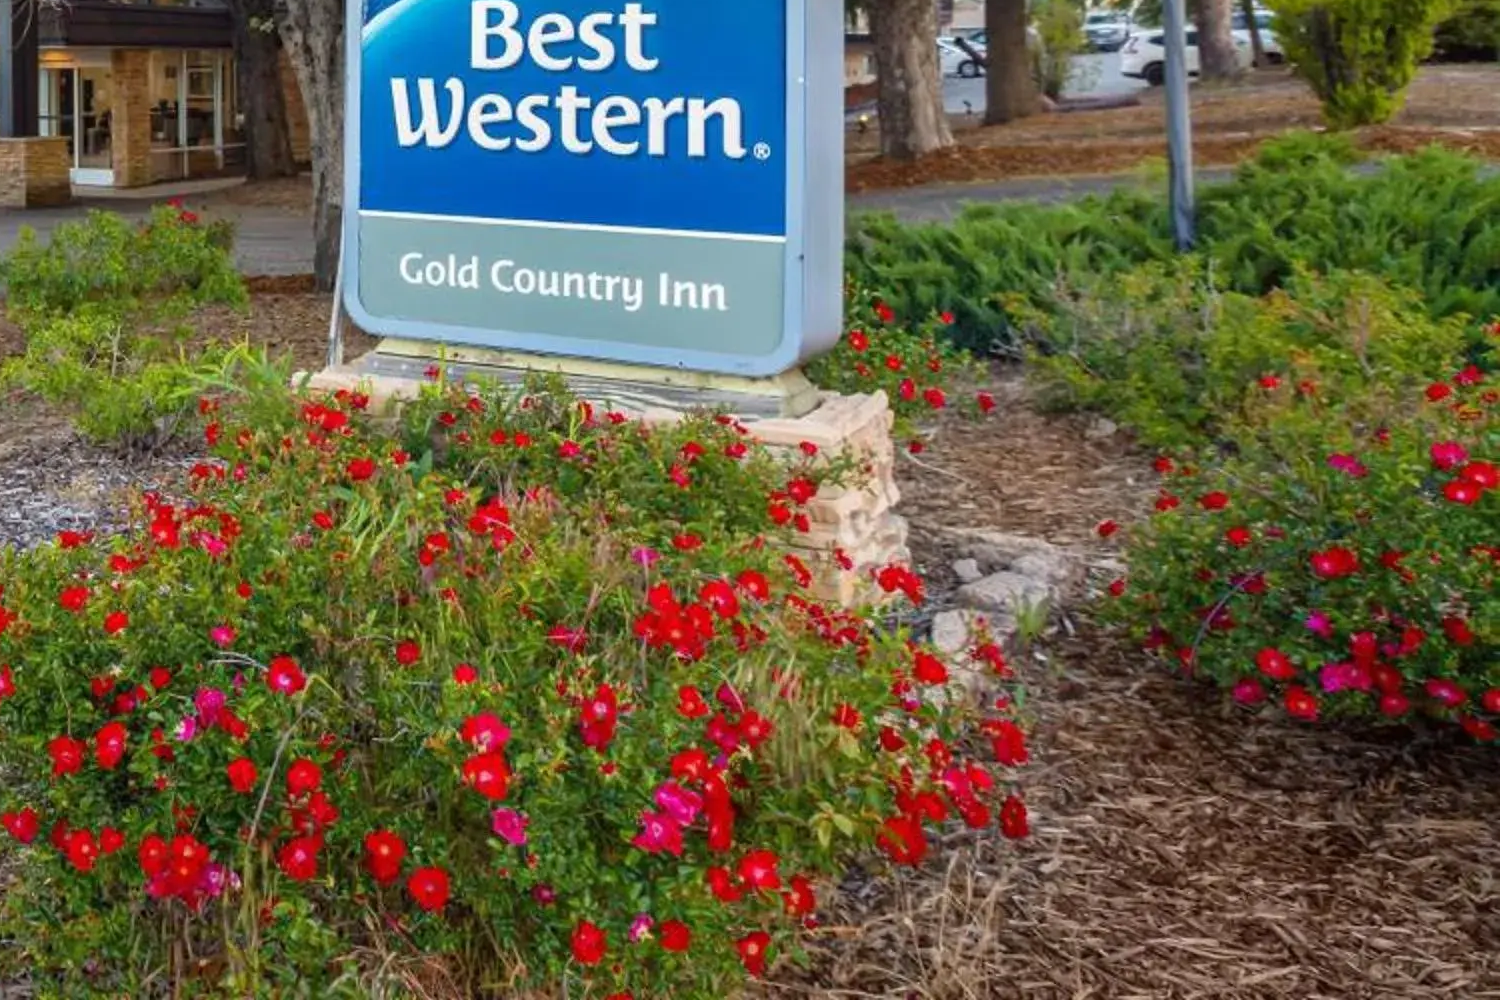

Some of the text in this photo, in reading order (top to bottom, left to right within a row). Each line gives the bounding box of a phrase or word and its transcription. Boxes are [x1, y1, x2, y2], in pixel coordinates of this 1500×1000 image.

[398, 252, 728, 312] Gold Country Inn
